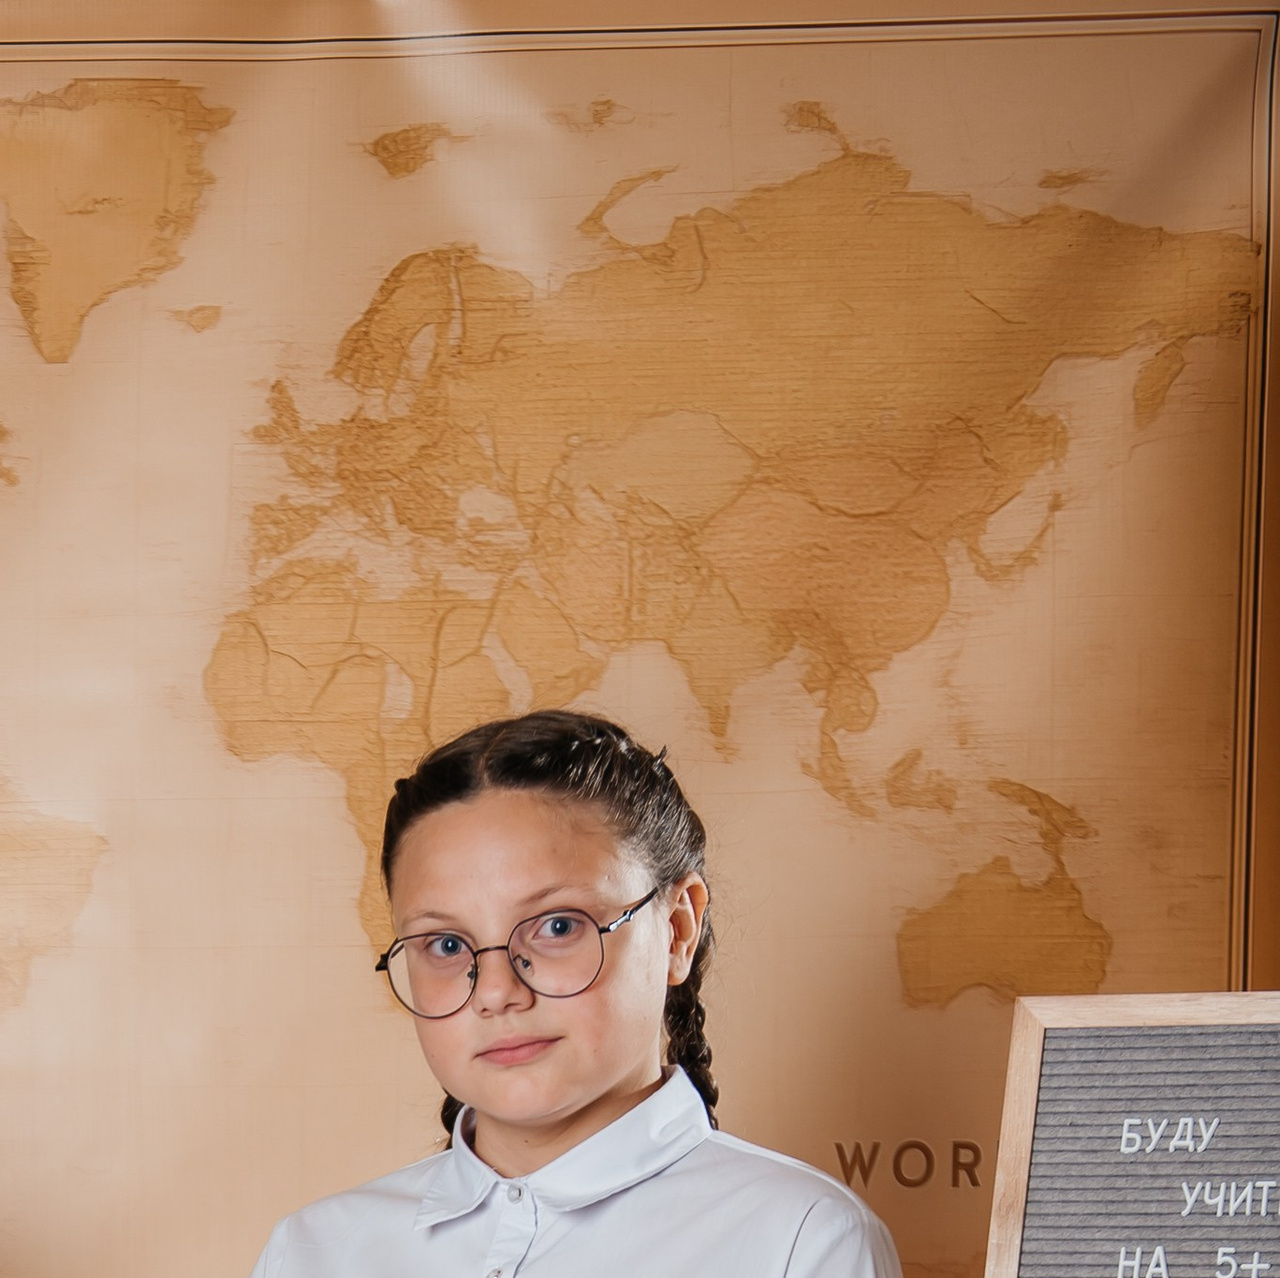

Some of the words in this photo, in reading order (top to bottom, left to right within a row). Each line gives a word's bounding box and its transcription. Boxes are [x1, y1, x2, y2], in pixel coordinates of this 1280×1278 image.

[1120, 1117, 1221, 1154] БУДУ
[833, 1139, 1000, 1190] WOR
[1180, 1181, 1280, 1218] УЧИТ
